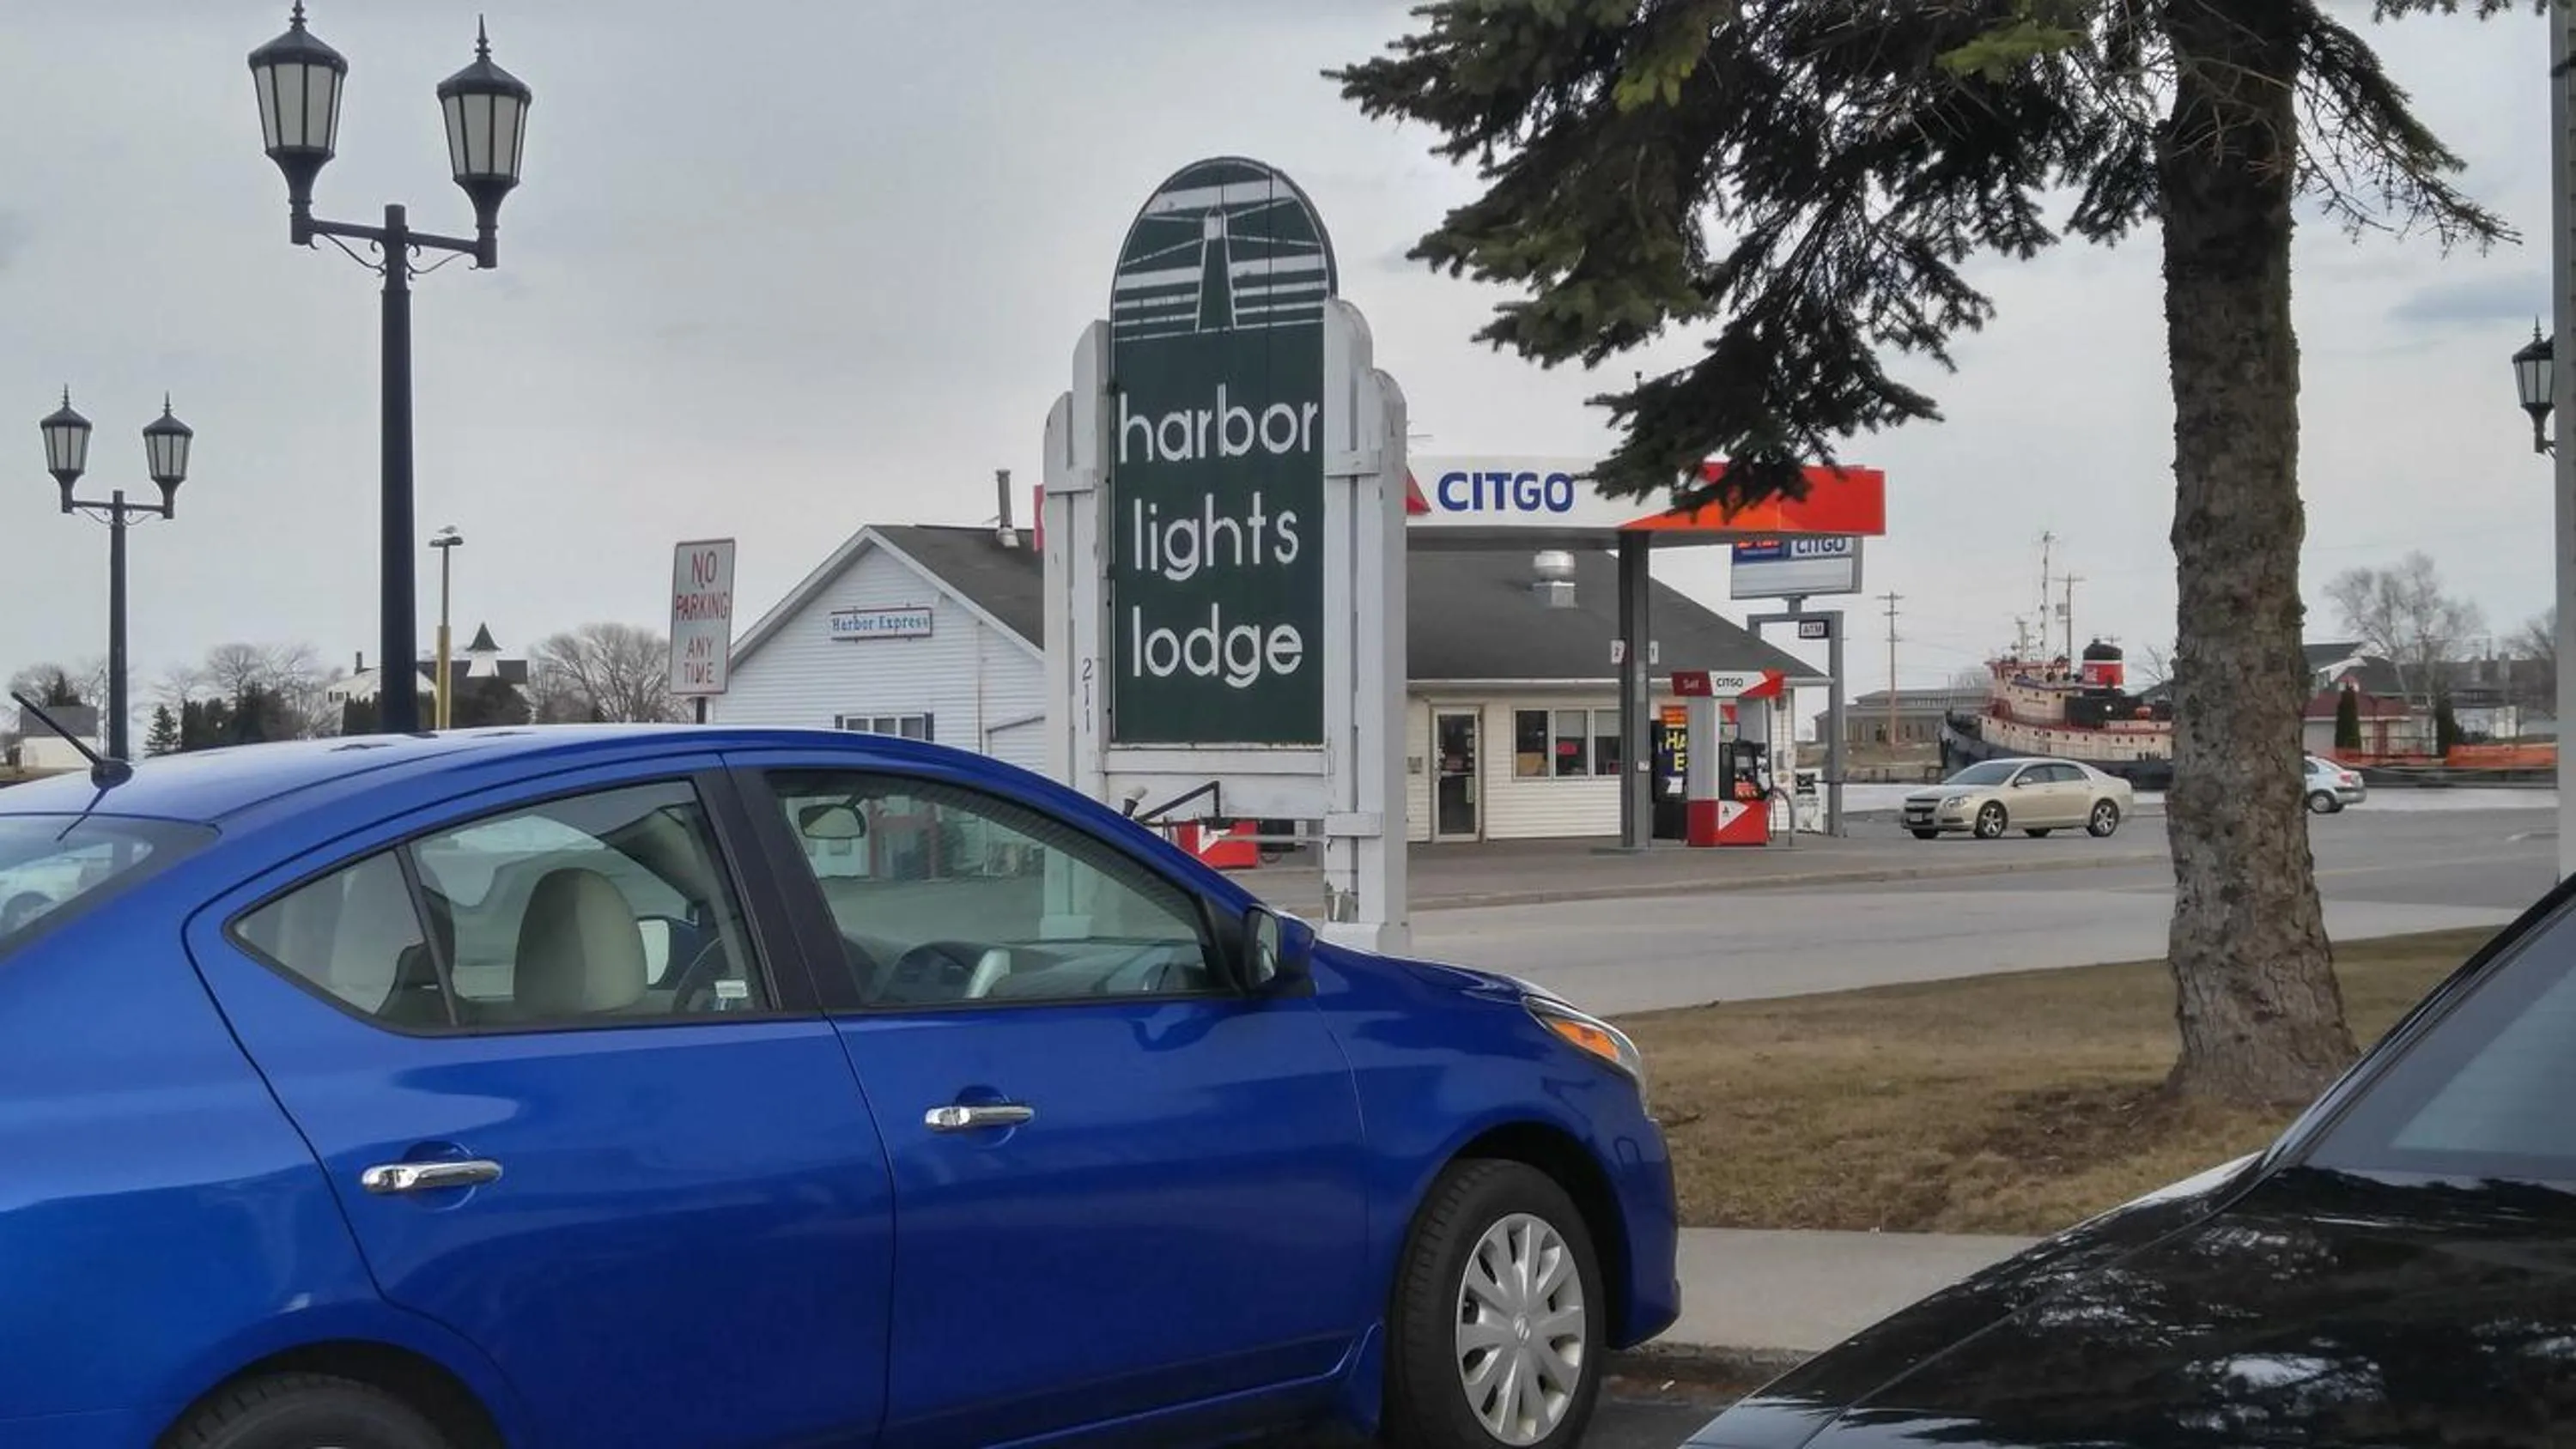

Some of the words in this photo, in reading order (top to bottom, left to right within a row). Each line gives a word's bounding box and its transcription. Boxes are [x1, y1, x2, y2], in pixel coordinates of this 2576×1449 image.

[1119, 384, 1317, 464] harbor
[1437, 470, 1575, 512] CITGO
[1133, 491, 1300, 582] lights
[1795, 537, 1846, 555] CITGO
[691, 550, 718, 584] NO
[675, 592, 729, 621] PARKING
[831, 615, 875, 632] Harbor
[878, 615, 928, 634] Express
[1802, 623, 1823, 634] ATM
[685, 634, 715, 660] ANY
[1132, 603, 1303, 688] lodge
[683, 661, 715, 685] TIME
[1716, 676, 1744, 688] CITGO
